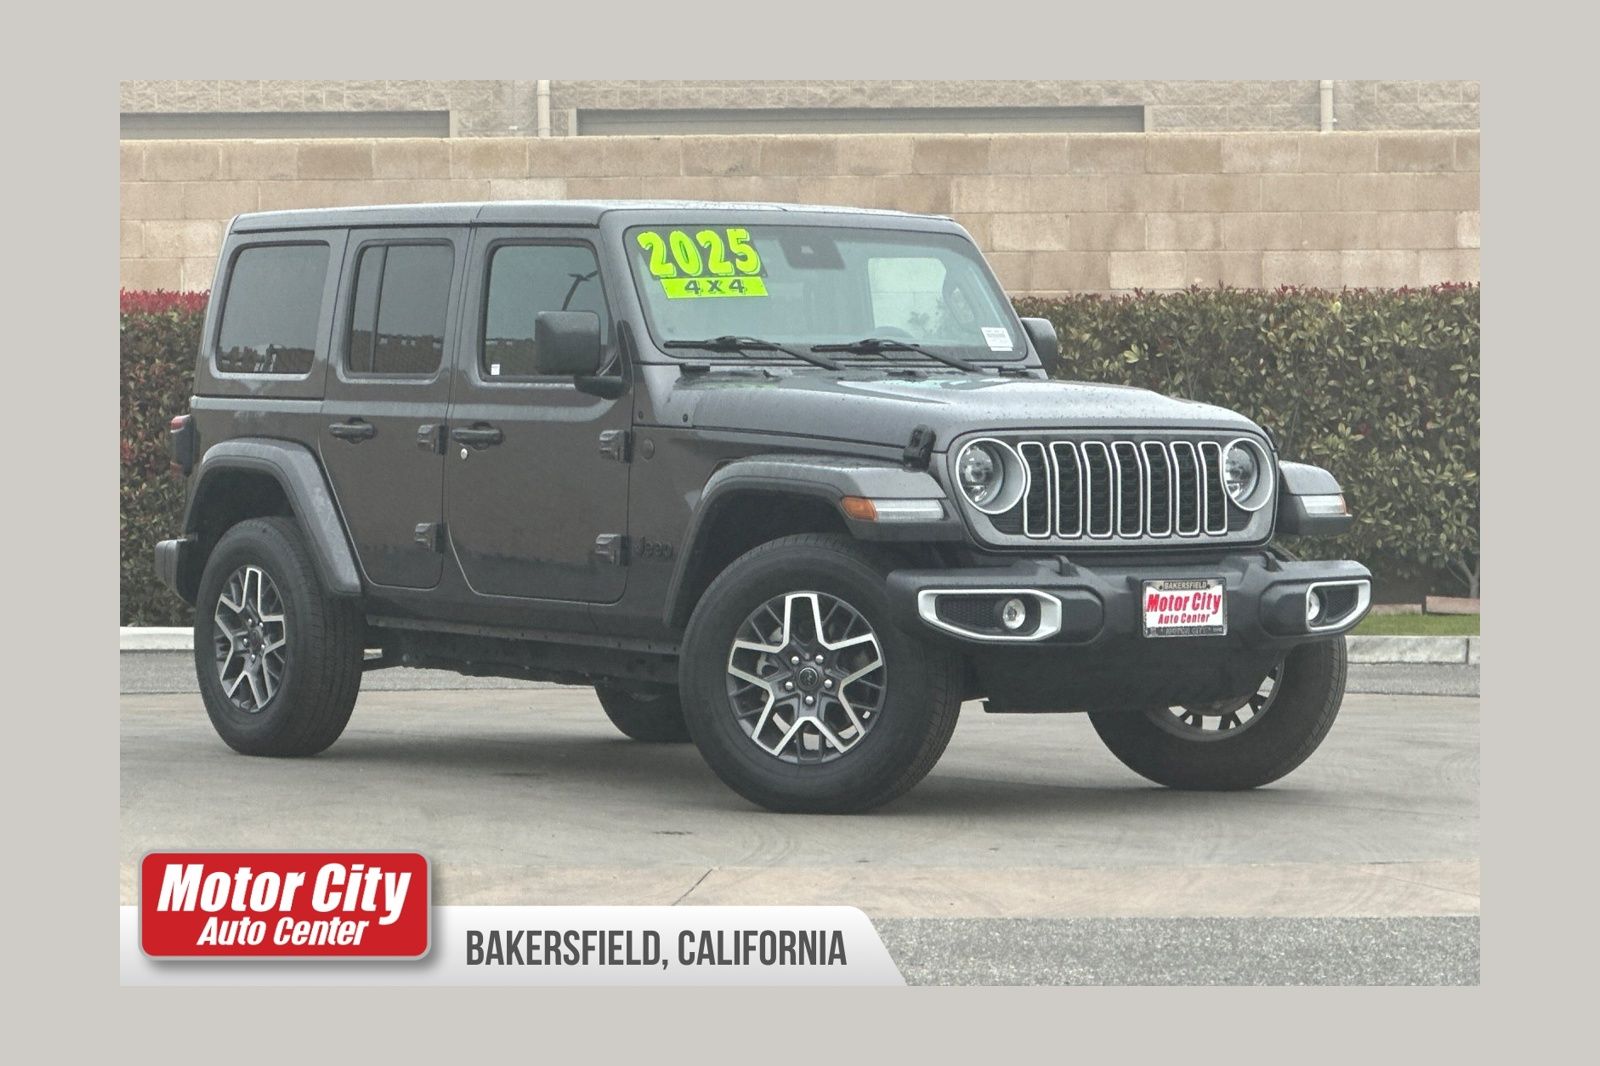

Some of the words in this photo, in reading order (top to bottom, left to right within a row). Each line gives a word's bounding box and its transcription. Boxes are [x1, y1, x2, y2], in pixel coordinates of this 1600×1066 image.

[637, 228, 761, 277] 2025
[1164, 581, 1207, 589] BAKERSFIELD
[1146, 594, 1190, 612] Motor
[1192, 592, 1221, 614] City
[1158, 614, 1179, 624] Auto
[1180, 613, 1210, 623] Center
